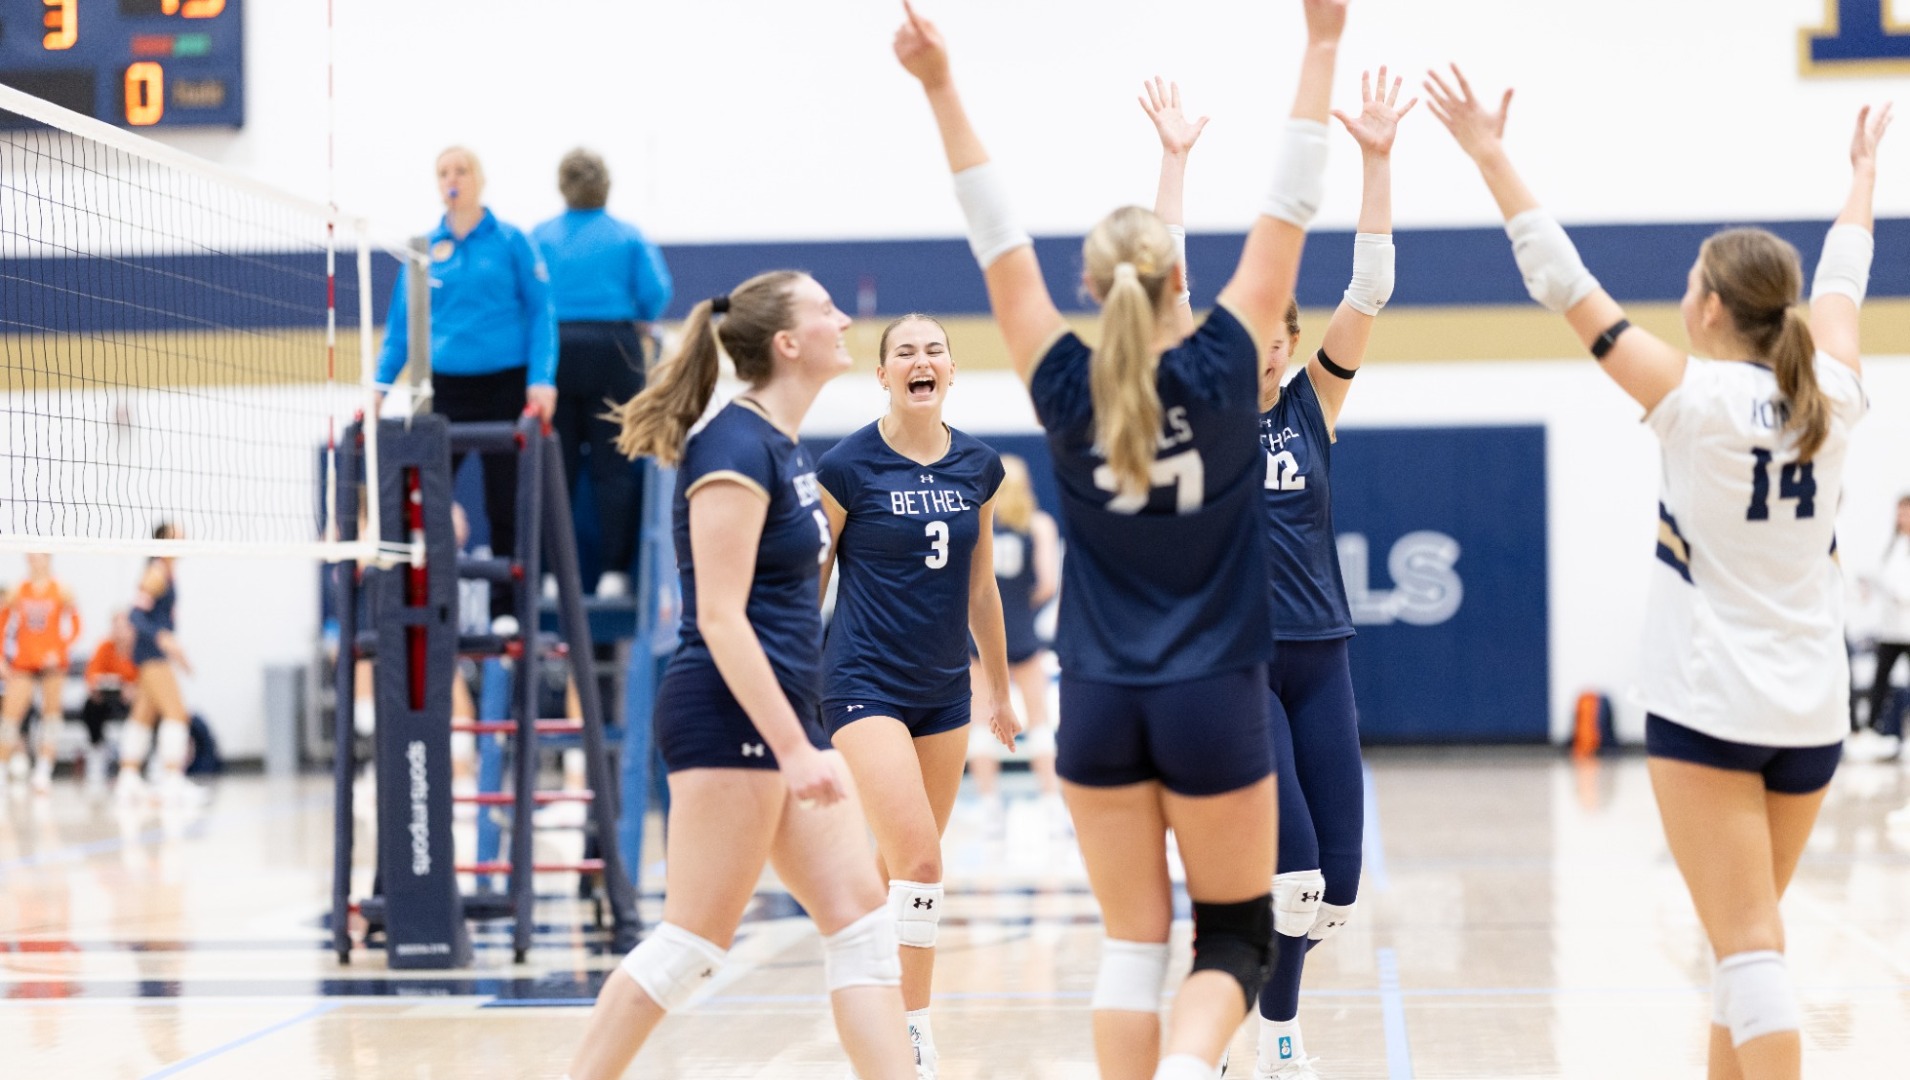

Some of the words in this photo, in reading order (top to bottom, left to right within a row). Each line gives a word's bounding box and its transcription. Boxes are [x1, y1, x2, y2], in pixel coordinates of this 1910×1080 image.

[42, 0, 78, 50] 3
[124, 62, 164, 126] 0
[1263, 449, 1306, 491] 12
[1745, 446, 1817, 521] 14
[890, 489, 971, 515] BETHEL
[924, 520, 949, 570] 3
[1334, 530, 1465, 626] LS
